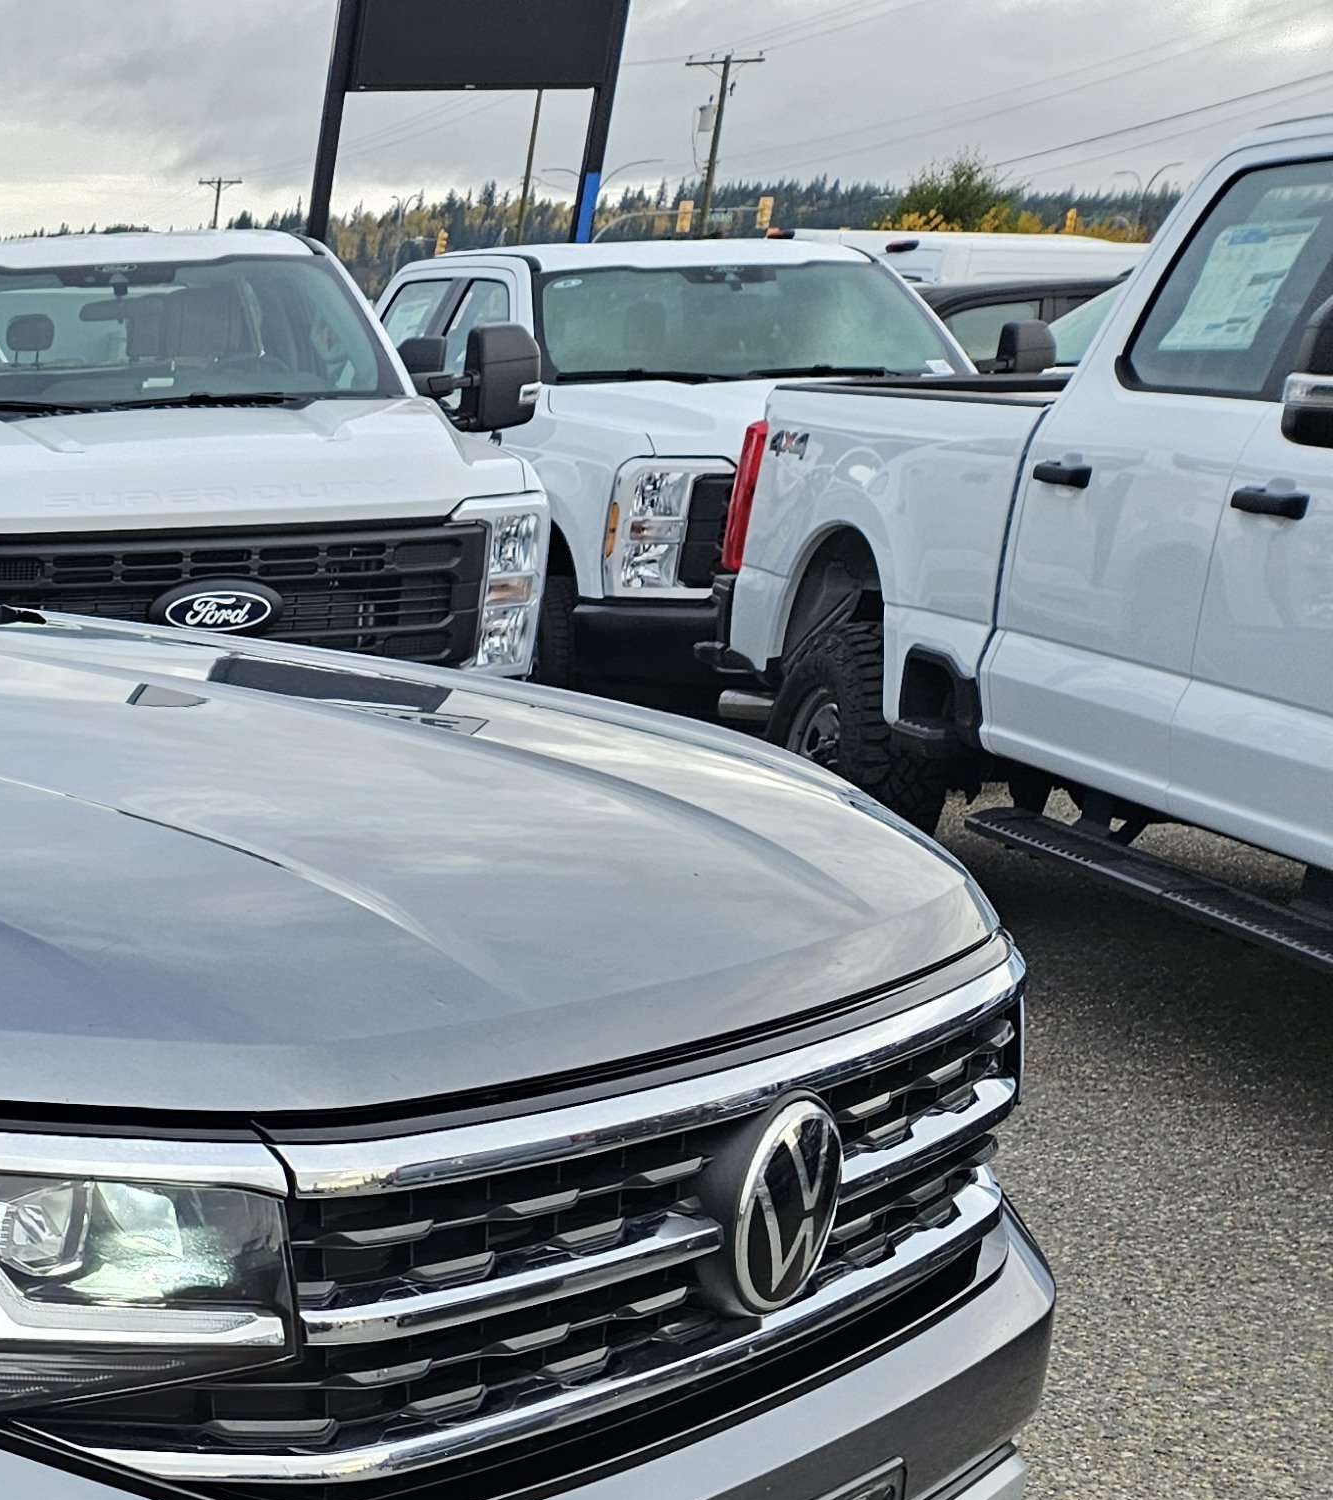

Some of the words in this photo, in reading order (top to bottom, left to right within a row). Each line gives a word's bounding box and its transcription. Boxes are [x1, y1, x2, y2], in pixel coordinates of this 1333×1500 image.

[44, 485, 239, 509] SUPER
[252, 478, 398, 500] DUTY
[185, 597, 251, 625] Ford
